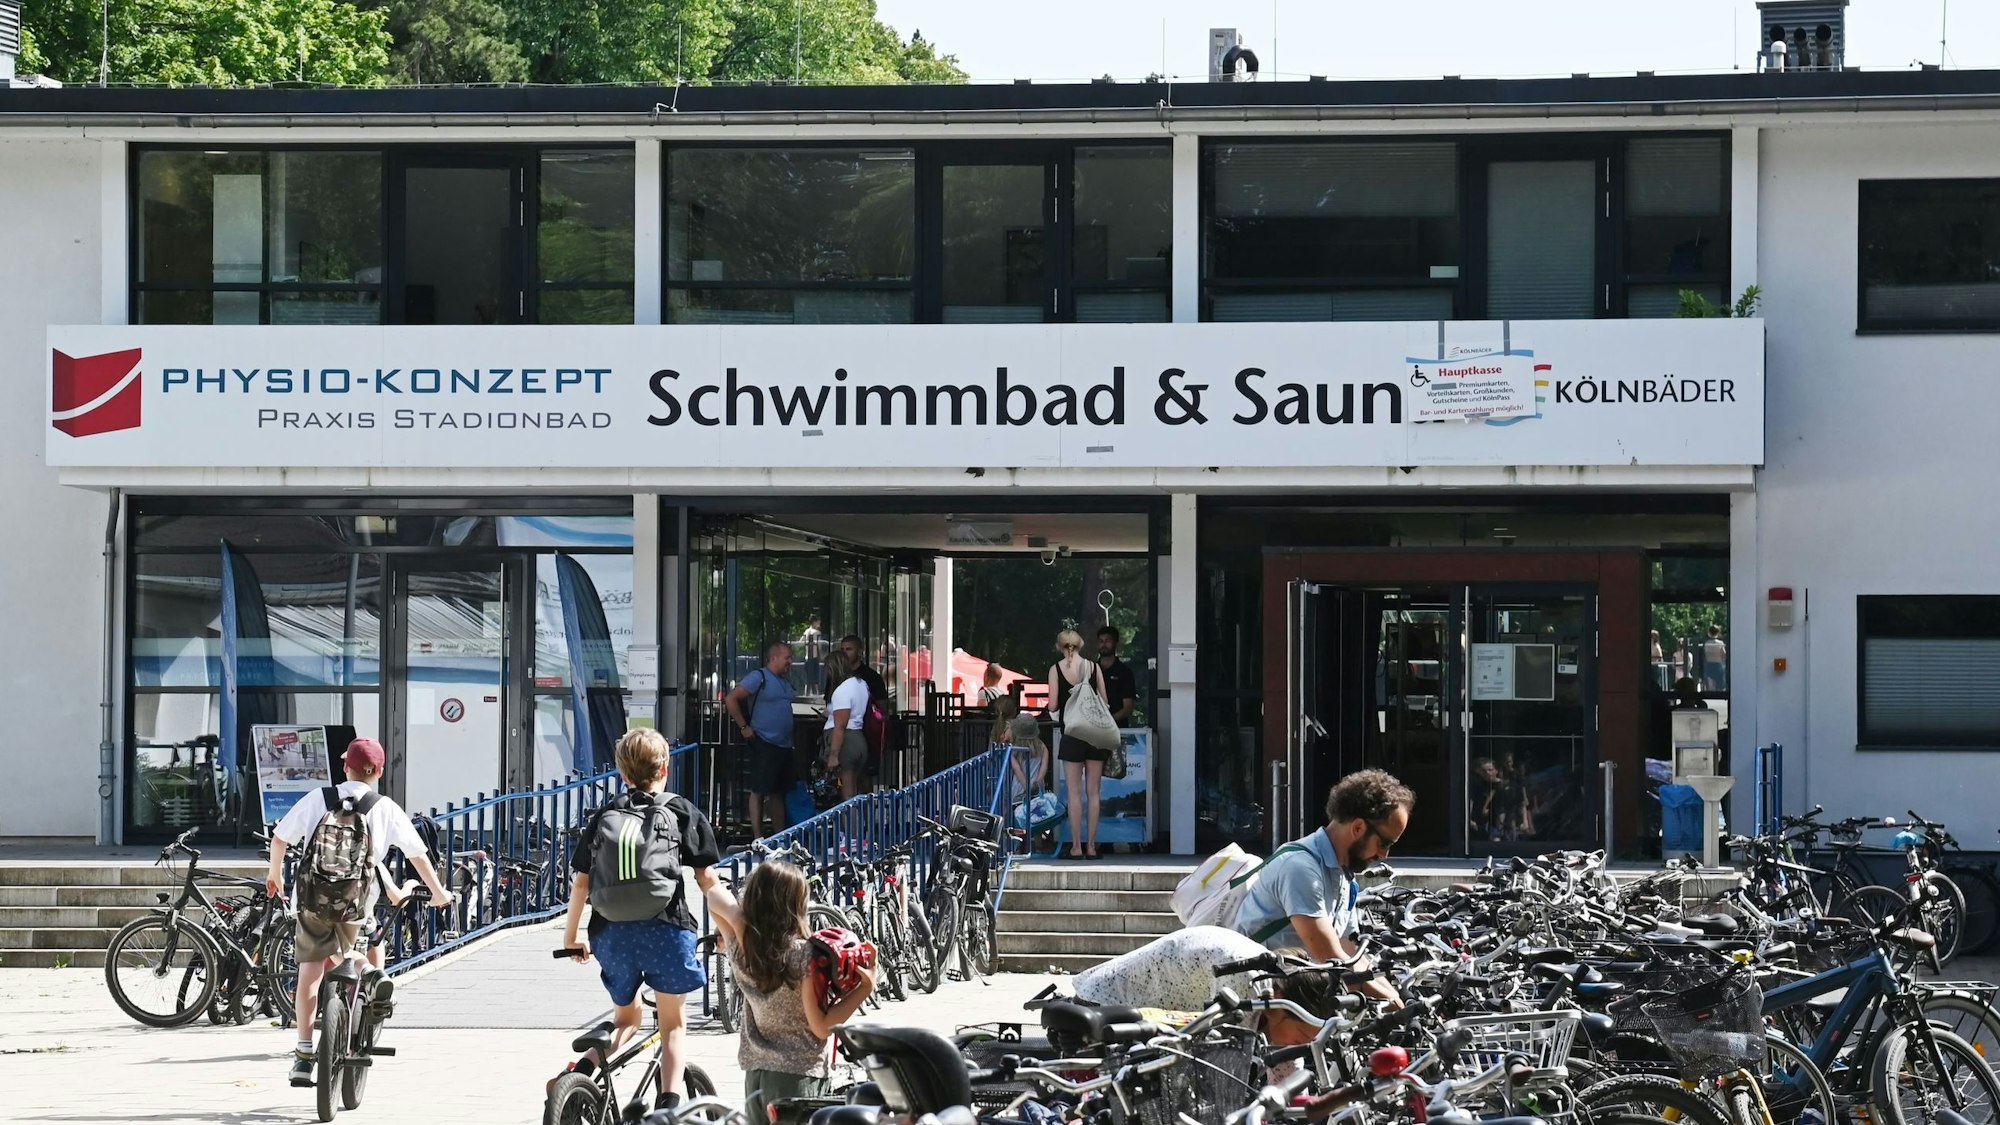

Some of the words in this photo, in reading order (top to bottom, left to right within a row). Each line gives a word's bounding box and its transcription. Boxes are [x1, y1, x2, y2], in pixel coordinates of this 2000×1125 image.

[1438, 366, 1502, 378] Hauptkasse
[162, 368, 612, 394] PHYSIO-KONZEPT
[1458, 380, 1510, 389] Premiumkarten,
[1426, 390, 1472, 398] Vorteilskarten,
[1473, 387, 1515, 395] Großkunden,
[1556, 374, 1736, 404] KÖLNBÄDER
[647, 367, 1125, 426] Schwimmbad
[1154, 368, 1208, 426] &
[1232, 368, 1403, 426] Saun
[1482, 394, 1510, 402] KölnPass
[1448, 406, 1494, 414] Kartenzahlung
[1495, 404, 1524, 413] möglich!
